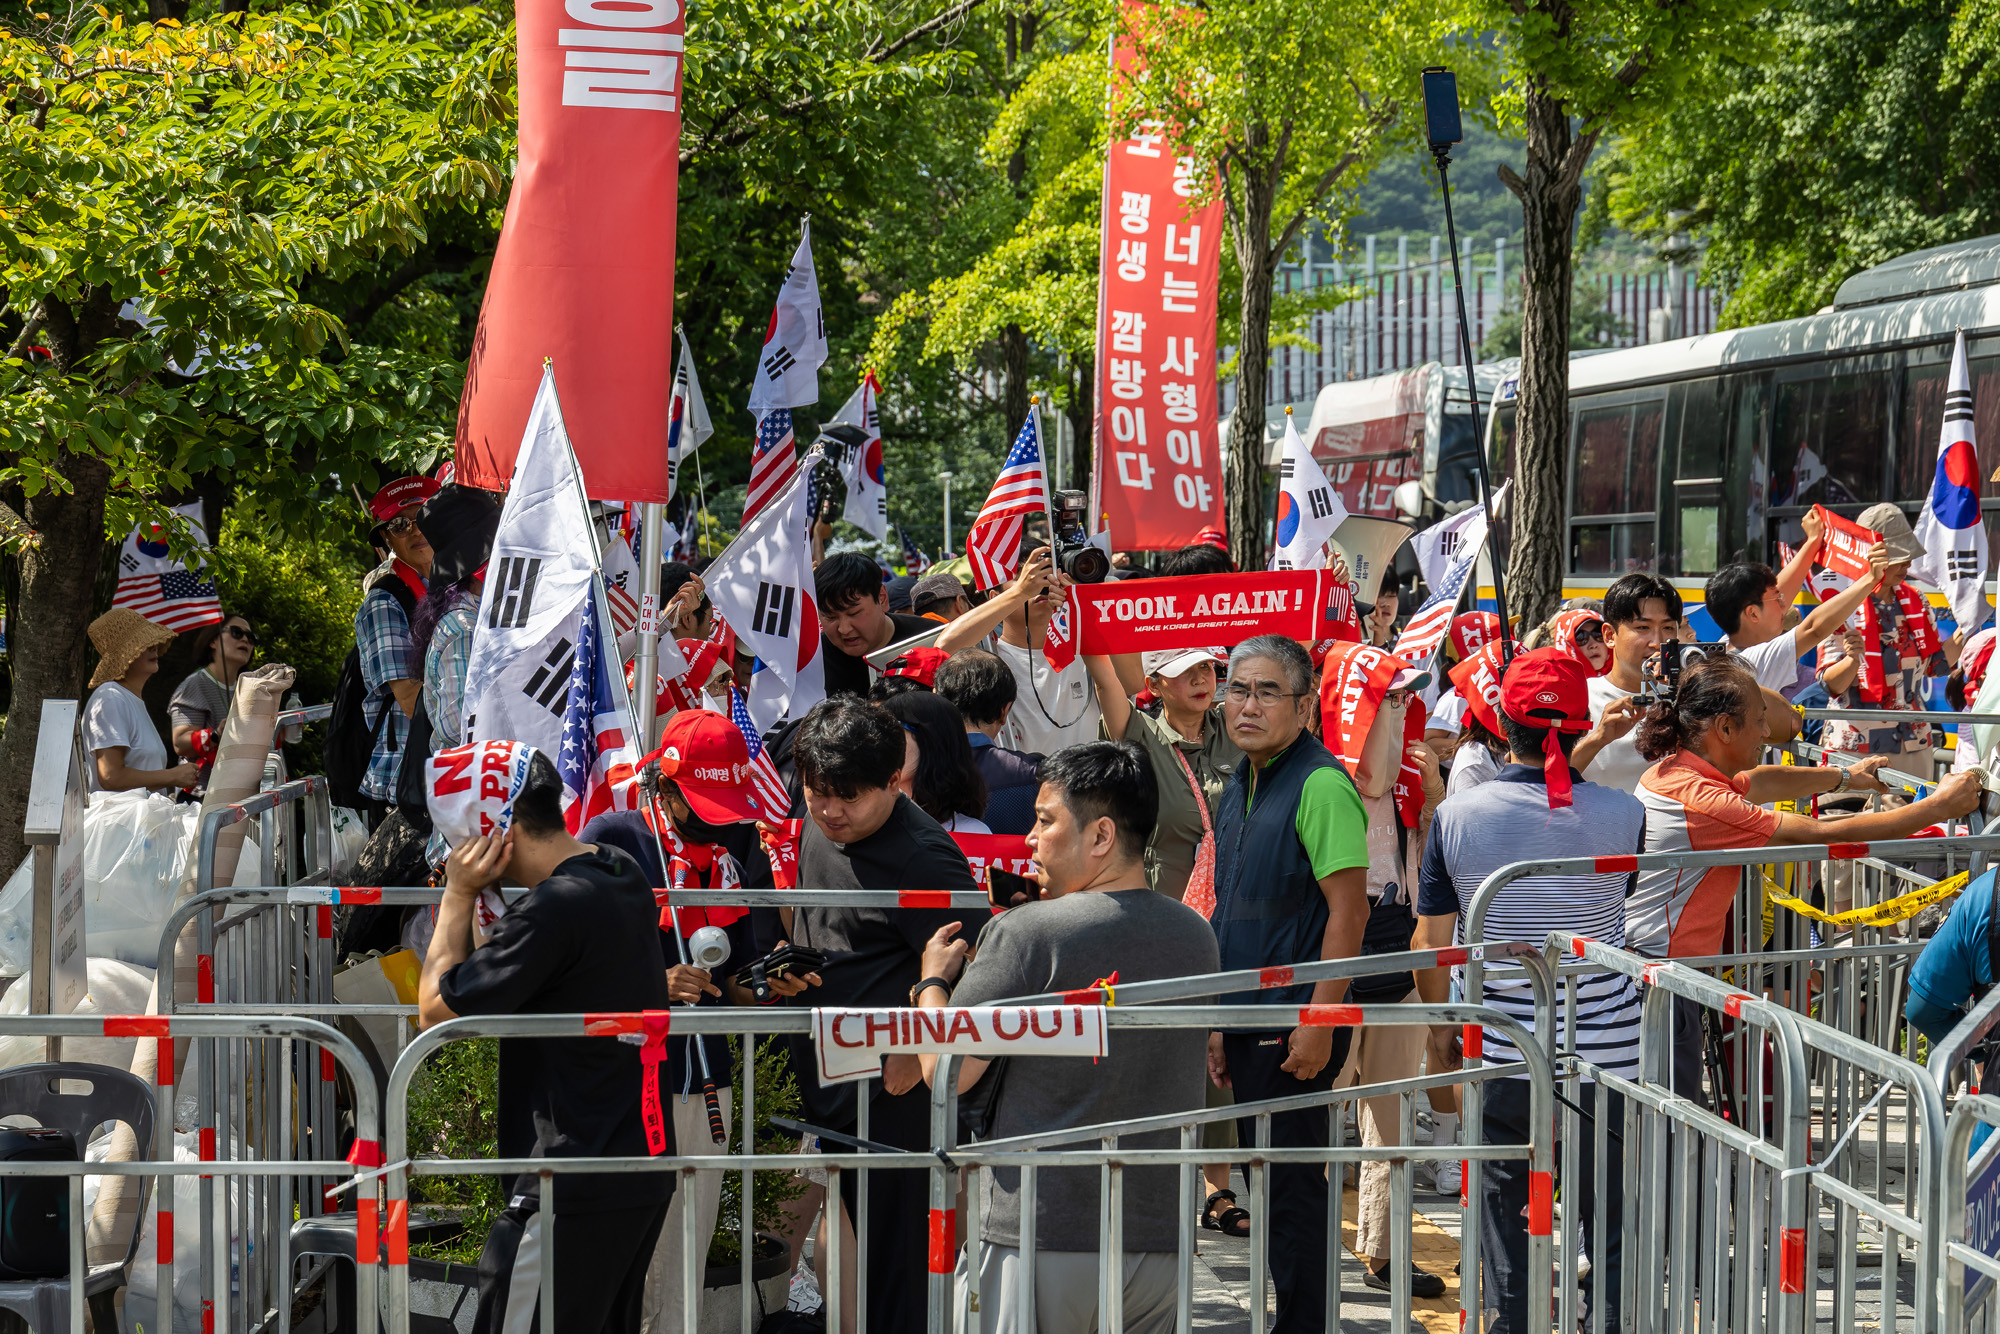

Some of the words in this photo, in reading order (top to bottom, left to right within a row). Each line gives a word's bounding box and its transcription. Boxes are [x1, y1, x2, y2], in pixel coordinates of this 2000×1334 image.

[1116, 191, 1151, 282] 평생
[1160, 224, 1200, 313] 너는
[1109, 310, 1155, 490] 깜방이다
[1160, 336, 1213, 512] 사형이야
[386, 486, 403, 497] YOON
[1092, 595, 1184, 623] YOON,
[1191, 589, 1289, 617] AGAIN
[1294, 589, 1303, 611] !
[1134, 625, 1161, 633] MAKE
[1162, 622, 1195, 631] KOREA
[1196, 621, 1228, 629] GREAT
[1229, 619, 1259, 627] AGAIN
[694, 767, 730, 782] 이재명
[832, 1009, 982, 1048] CHINA
[992, 1005, 1085, 1041] OUT
